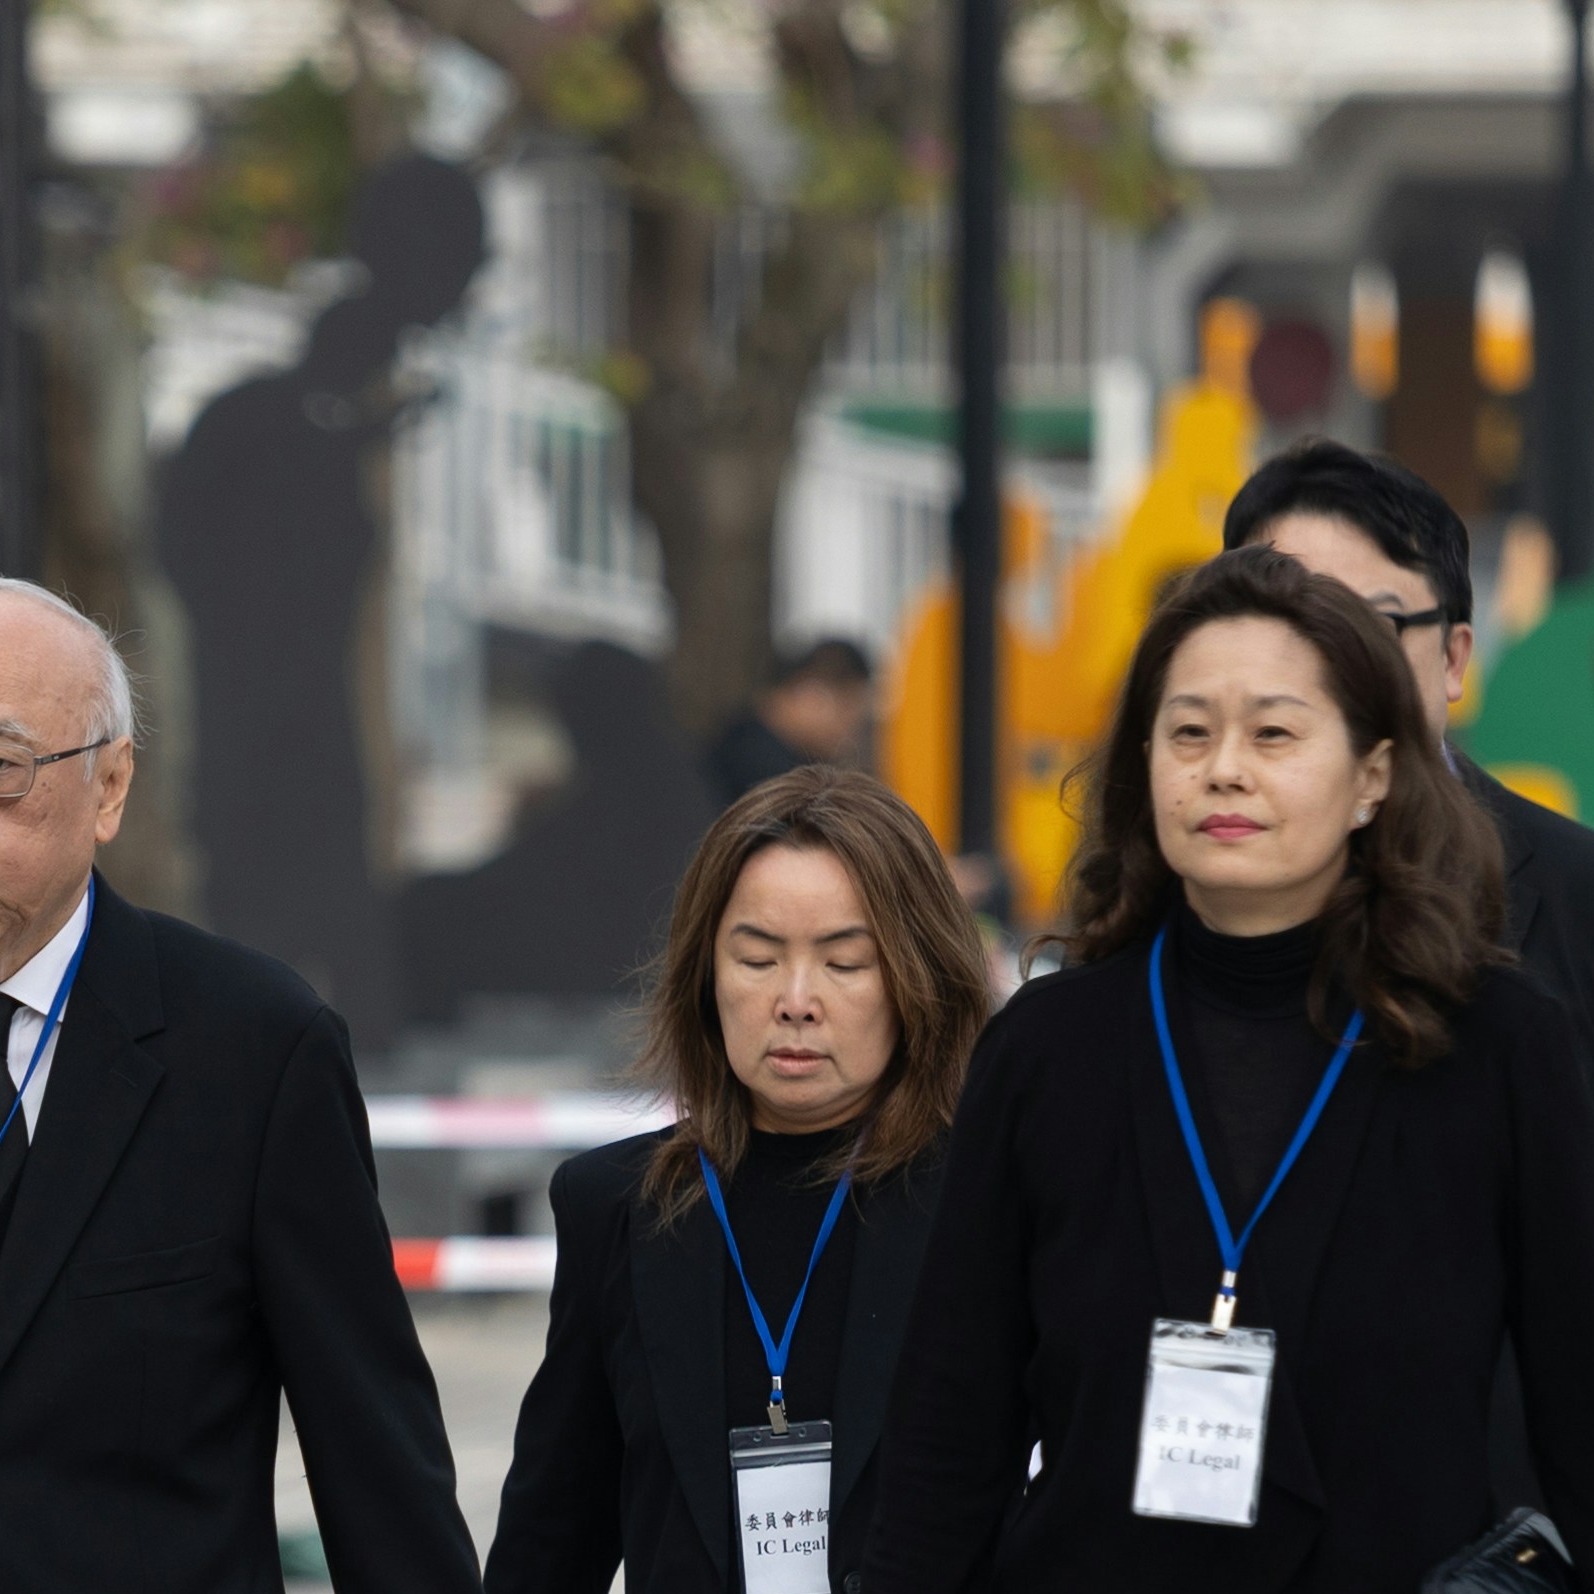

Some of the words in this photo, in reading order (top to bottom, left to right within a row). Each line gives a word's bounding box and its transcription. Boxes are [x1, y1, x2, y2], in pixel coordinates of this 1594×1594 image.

[1152, 1414, 1255, 1442] 委員會律師
[1158, 1445, 1182, 1463] IC
[1188, 1448, 1240, 1472] Legal
[745, 1508, 829, 1531] 委員會律師
[756, 1539, 777, 1556] IC
[782, 1535, 827, 1556] Legal
